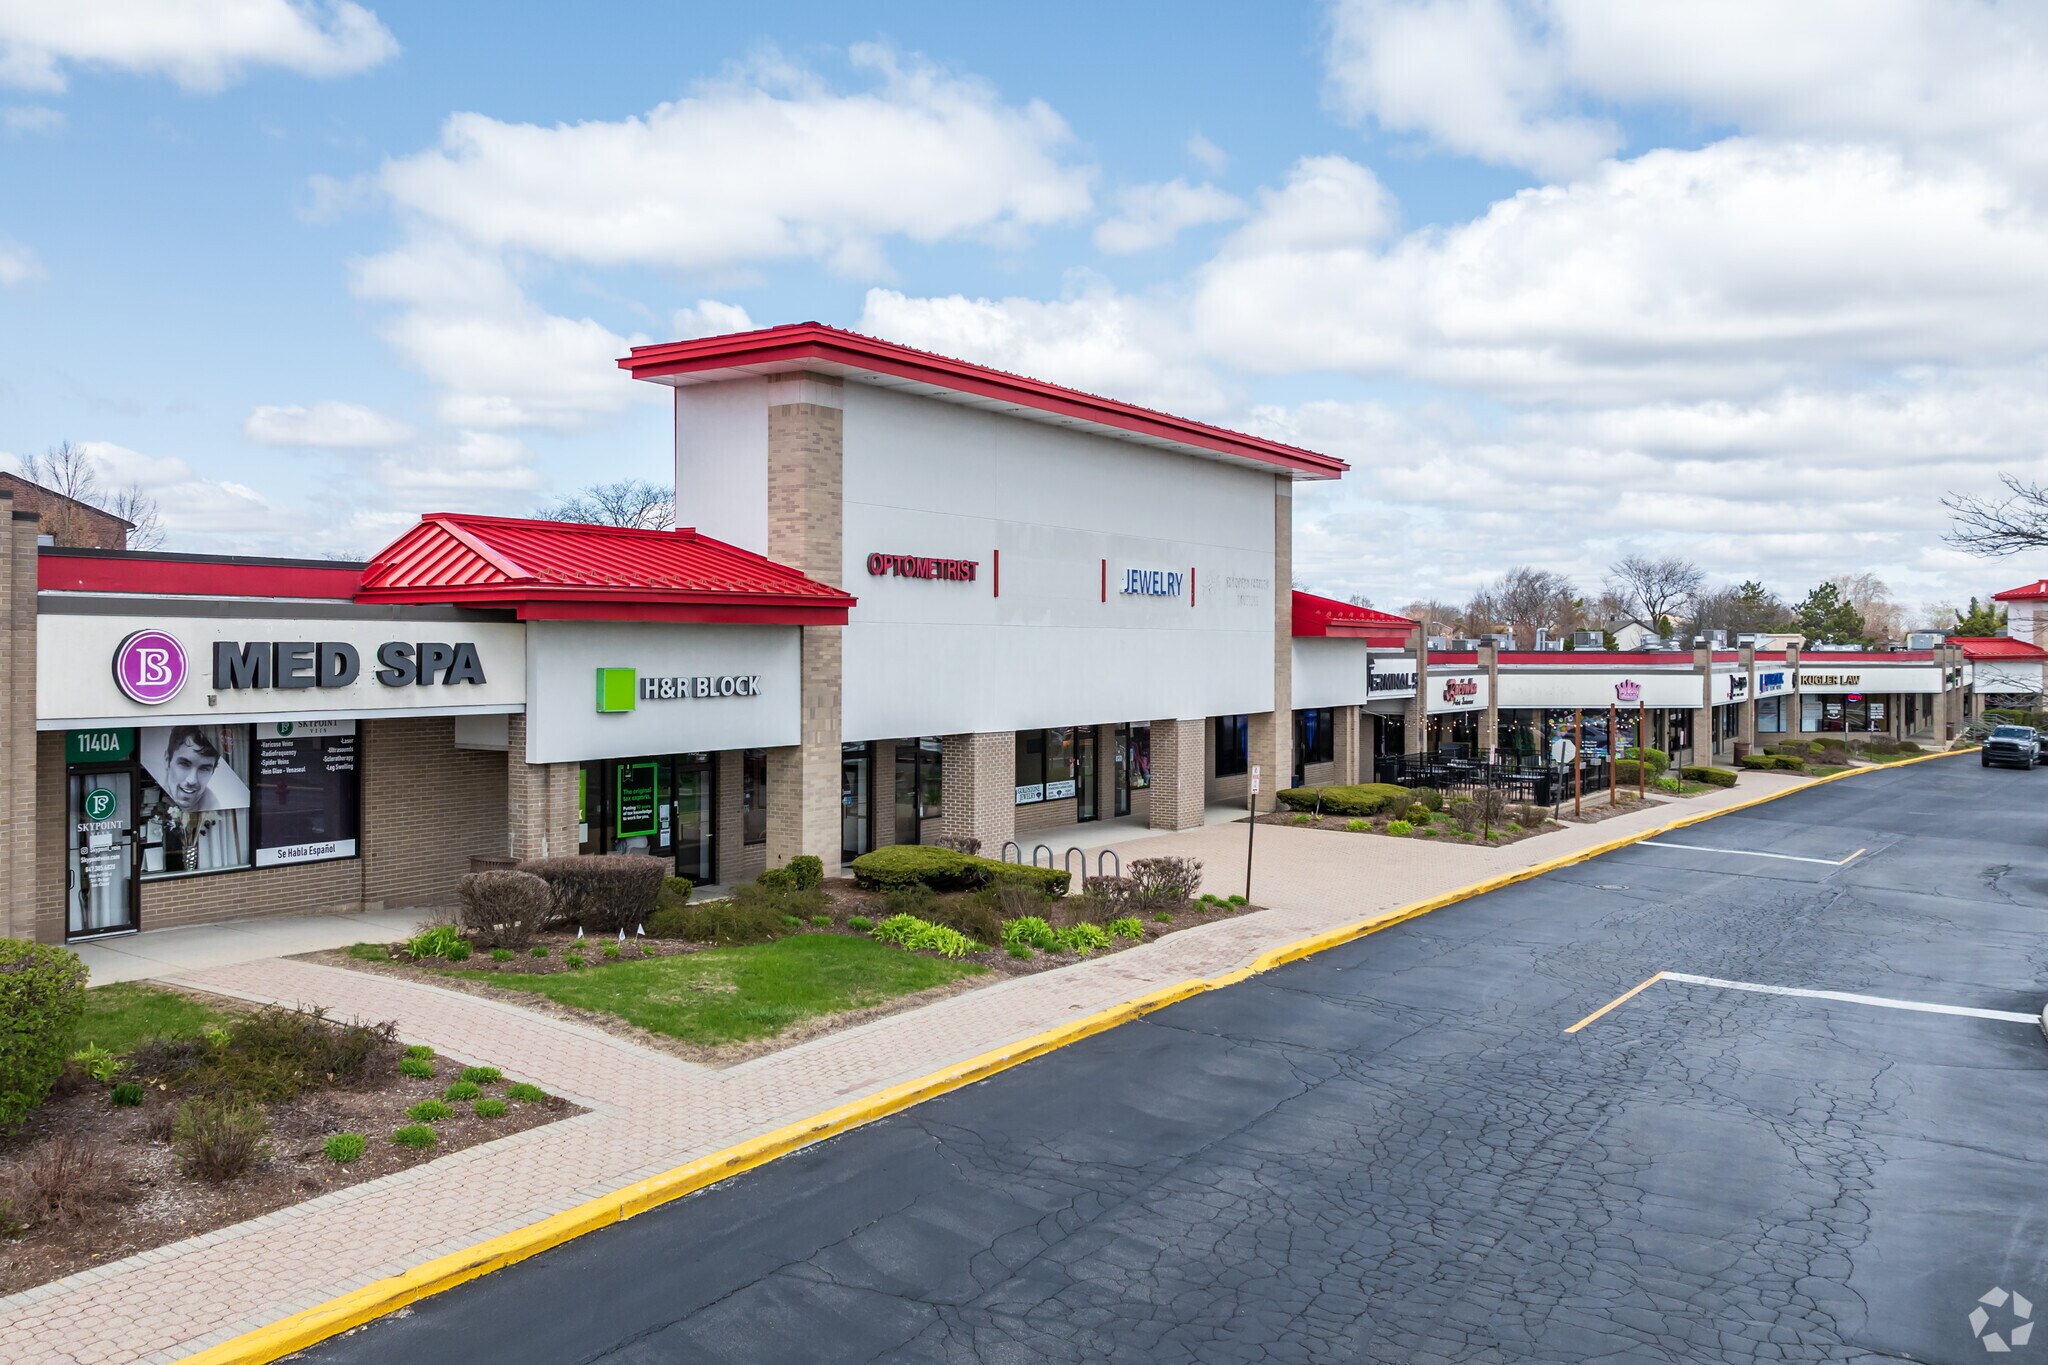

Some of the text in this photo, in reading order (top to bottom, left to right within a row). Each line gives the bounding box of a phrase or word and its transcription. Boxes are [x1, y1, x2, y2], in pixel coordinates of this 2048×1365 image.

[867, 553, 979, 581] OPTOMETRIST
[1124, 569, 1183, 595] JEWELRY
[213, 640, 487, 689] MED SPA
[1367, 660, 1411, 692] TERMINAL
[641, 675, 761, 699] H&R BLOCK
[1800, 675, 1838, 686] KUGLER
[1839, 675, 1860, 686] LAW
[78, 733, 120, 752] 1140A
[78, 820, 124, 832] SKYPOINT
[278, 844, 336, 858] Se Habla Español
